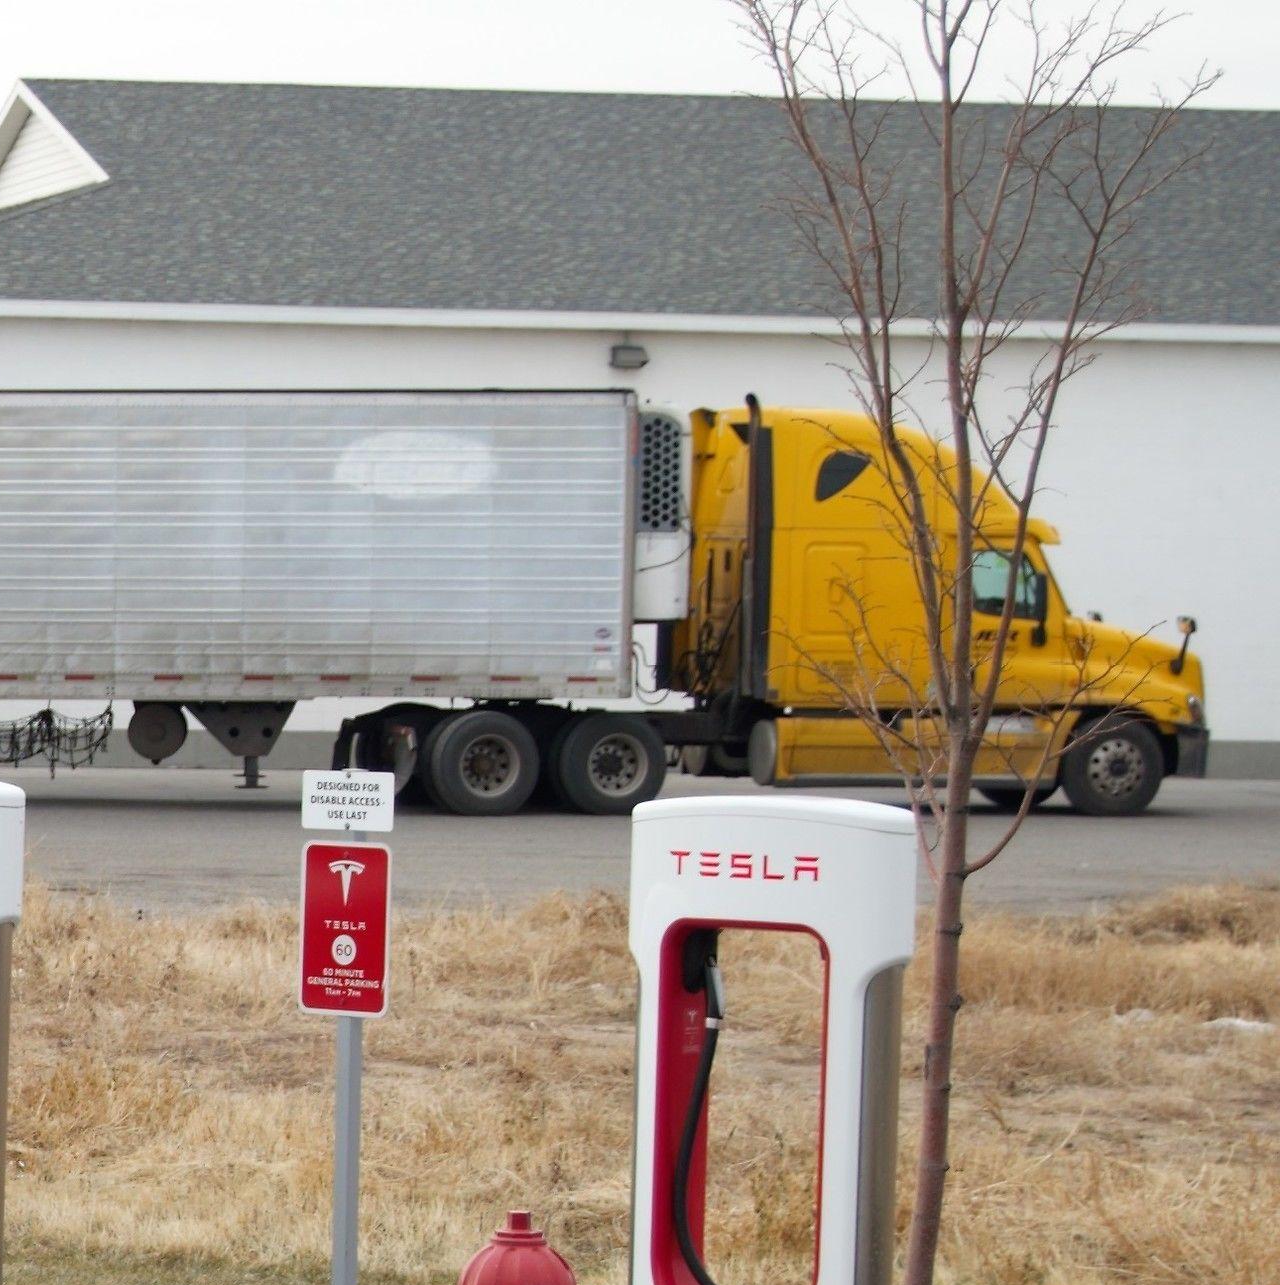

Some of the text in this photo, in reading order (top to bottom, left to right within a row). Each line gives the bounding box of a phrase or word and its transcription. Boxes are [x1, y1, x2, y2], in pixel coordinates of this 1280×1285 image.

[317, 782, 380, 792] DESIGNED FOR
[311, 795, 346, 805] DISABLE
[348, 797, 381, 806] ACCESS
[327, 810, 368, 820] USE LAST
[670, 850, 820, 881] TESLA
[324, 919, 366, 930] TESLA
[336, 944, 352, 956] 60
[335, 968, 364, 978] MINUTE
[307, 976, 380, 988] GENERAL PARKING
